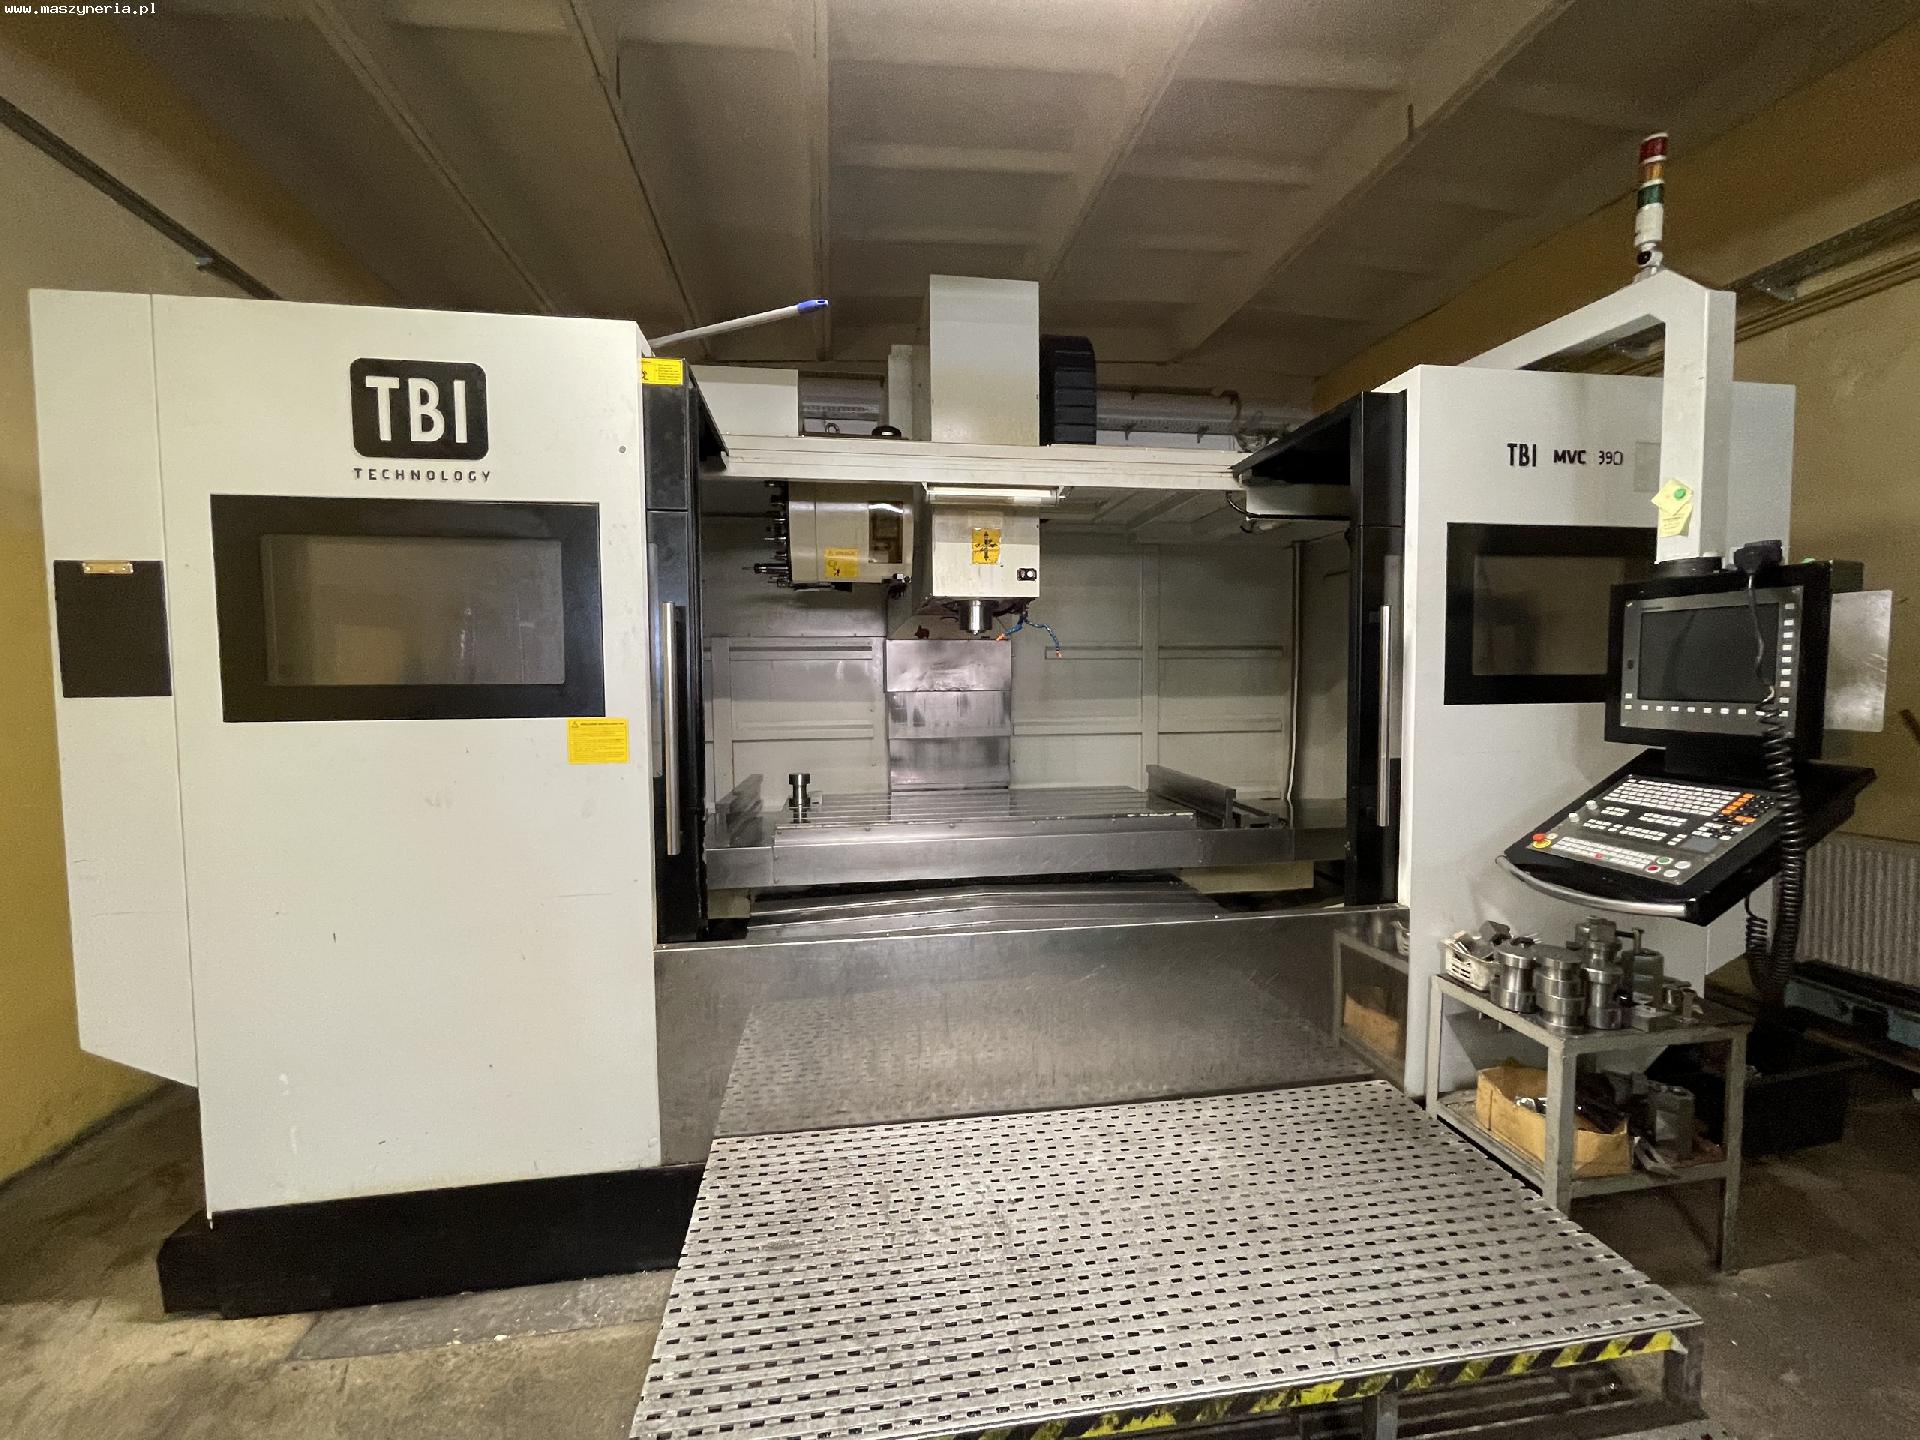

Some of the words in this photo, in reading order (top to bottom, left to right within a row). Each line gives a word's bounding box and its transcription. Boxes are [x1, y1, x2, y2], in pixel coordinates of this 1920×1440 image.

[365, 375, 468, 444] TBI
[1506, 442, 1537, 467] TBI
[1553, 449, 1587, 464] MVC
[353, 467, 491, 483] TECHNOLOGY
